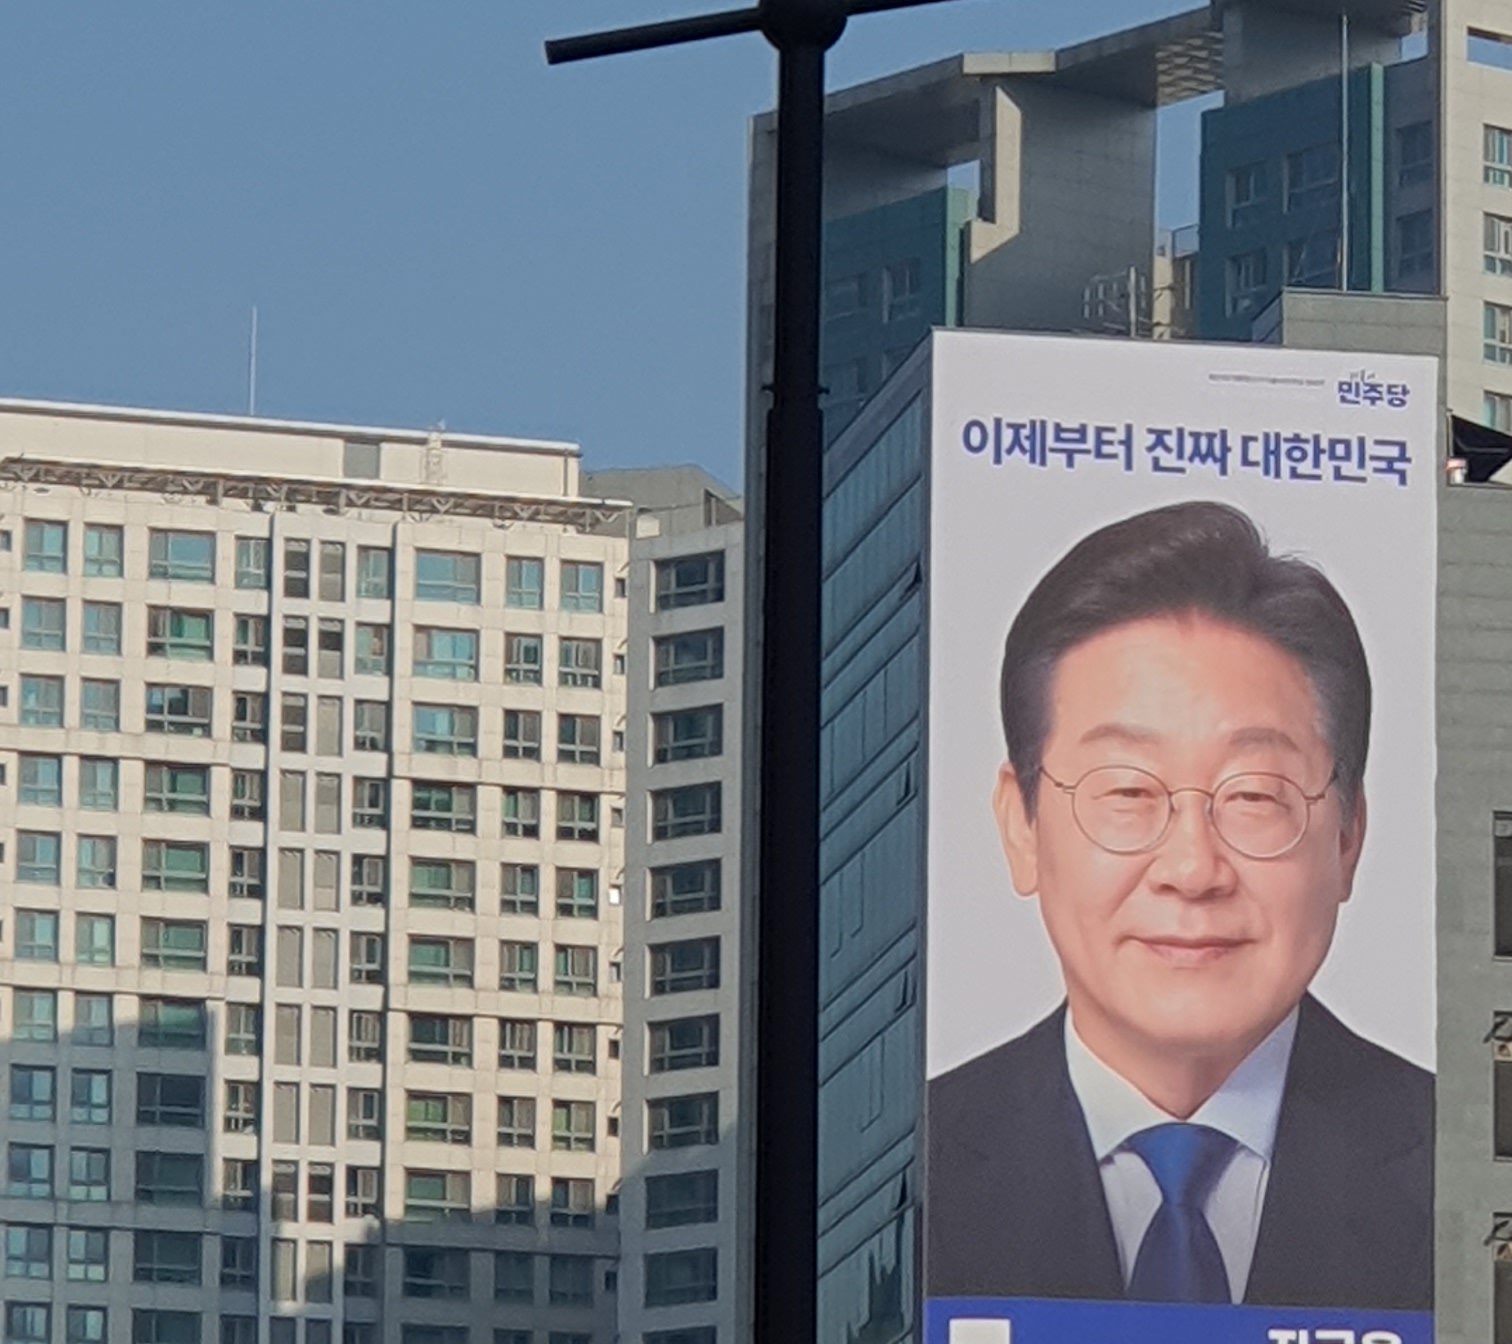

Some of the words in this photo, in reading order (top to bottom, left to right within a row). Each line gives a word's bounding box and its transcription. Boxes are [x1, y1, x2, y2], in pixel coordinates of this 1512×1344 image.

[1337, 379, 1410, 408] 민주당
[962, 416, 1134, 471] 이제부터
[1144, 427, 1232, 476] 진짜
[1239, 431, 1412, 486] 대한민국
